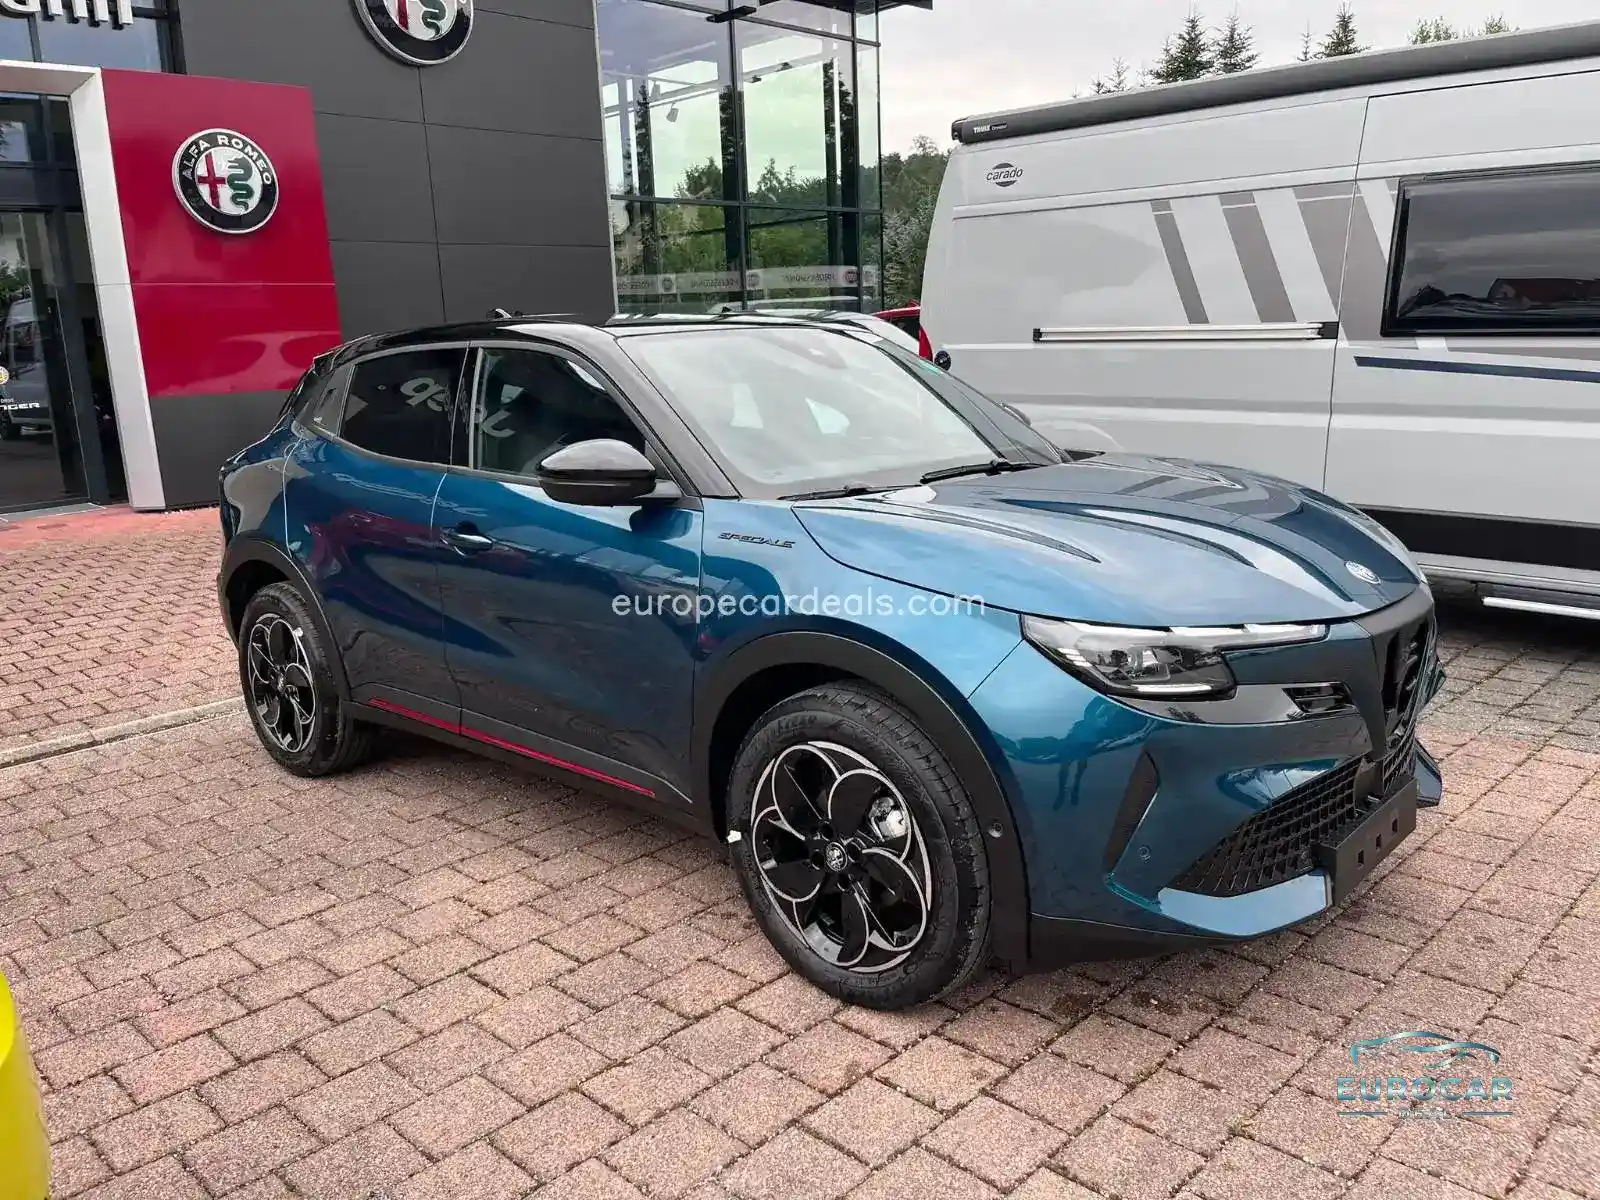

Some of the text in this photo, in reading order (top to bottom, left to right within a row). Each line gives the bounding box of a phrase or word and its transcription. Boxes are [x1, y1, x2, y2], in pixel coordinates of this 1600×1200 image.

[182, 134, 273, 185] ALFA ROMEO
[986, 166, 1024, 181] carado
[718, 532, 796, 549] SPECIALE
